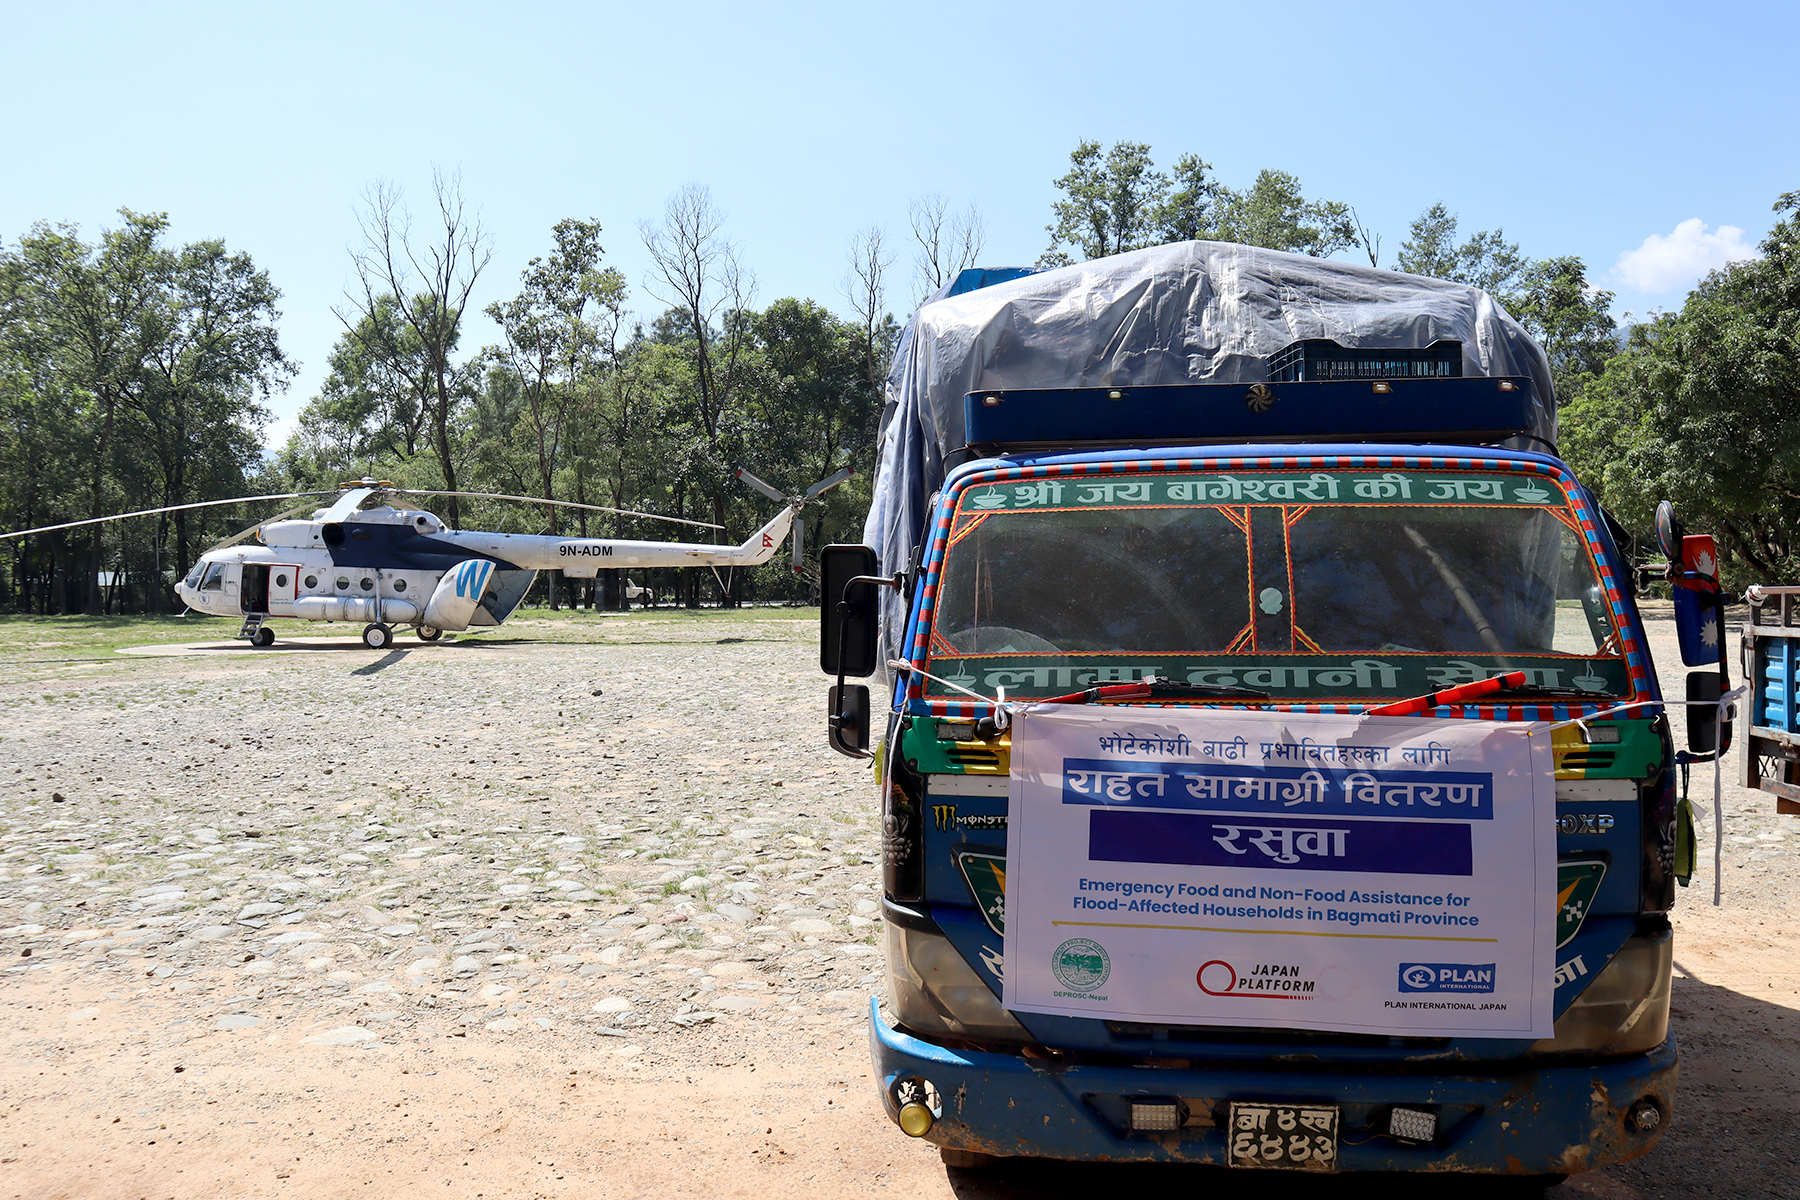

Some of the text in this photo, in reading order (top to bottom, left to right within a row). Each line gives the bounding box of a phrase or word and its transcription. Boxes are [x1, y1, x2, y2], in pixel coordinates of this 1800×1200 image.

[1014, 473, 1504, 507] श्री जय बागेश्वरी की जय
[559, 545, 613, 557] 9N-ADM
[1099, 732, 1191, 757] भोटेकोशी
[1203, 736, 1248, 760] बाढी
[1402, 741, 1451, 765] लागि
[1067, 769, 1484, 807] राहत सामाग्री वितरण
[1556, 814, 1614, 834] 0XP
[1212, 824, 1350, 864] रसुवा
[1079, 878, 1471, 907] Emergency Food and Non-Food Assistance for
[1073, 896, 1479, 926] Flood-Affected Households in Bagmati Province
[1251, 965, 1300, 977] JAPAN
[1439, 969, 1491, 983] PLAN
[1238, 978, 1315, 992] PLATFORM
[1054, 991, 1108, 1002] DEPROSC-Nepal
[1384, 1001, 1507, 1011] PLAN INTERNATIONAL JAPAN
